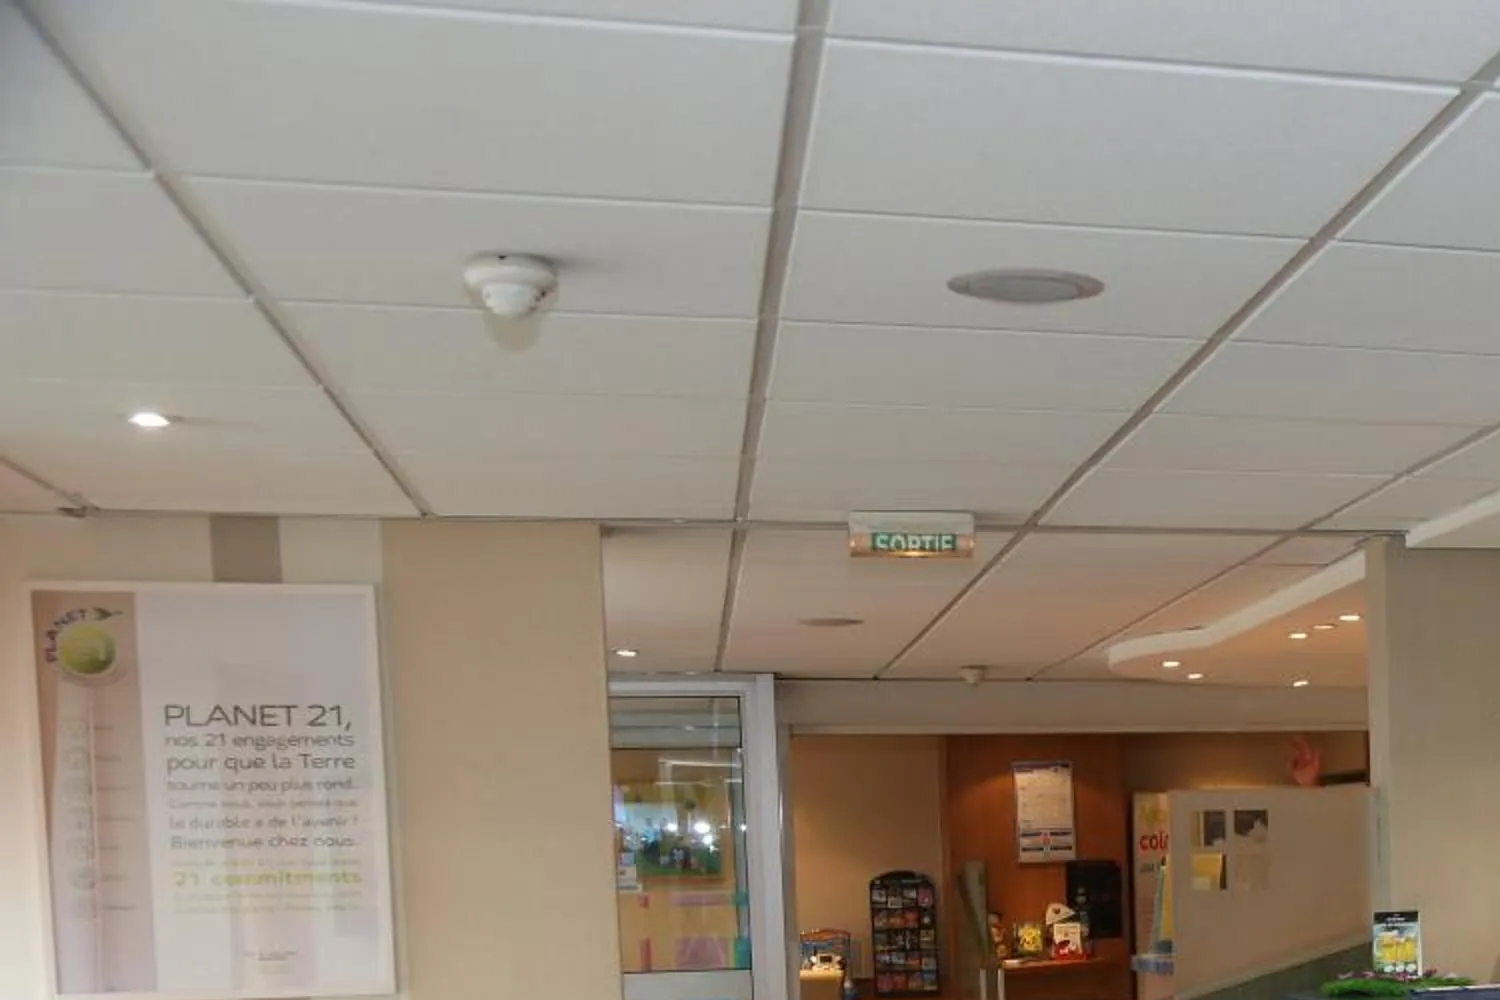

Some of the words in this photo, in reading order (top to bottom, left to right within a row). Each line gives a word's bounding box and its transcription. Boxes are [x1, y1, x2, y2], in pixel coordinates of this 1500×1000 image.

[164, 703, 298, 728] PLANET
[307, 704, 352, 731] 21,
[165, 735, 198, 748] nos
[204, 734, 227, 747] 21
[231, 733, 356, 751] engagements
[167, 756, 218, 775] pour
[223, 757, 266, 774] que
[271, 753, 293, 769] la
[298, 753, 356, 770] Terre
[171, 835, 263, 850] Bienvenue
